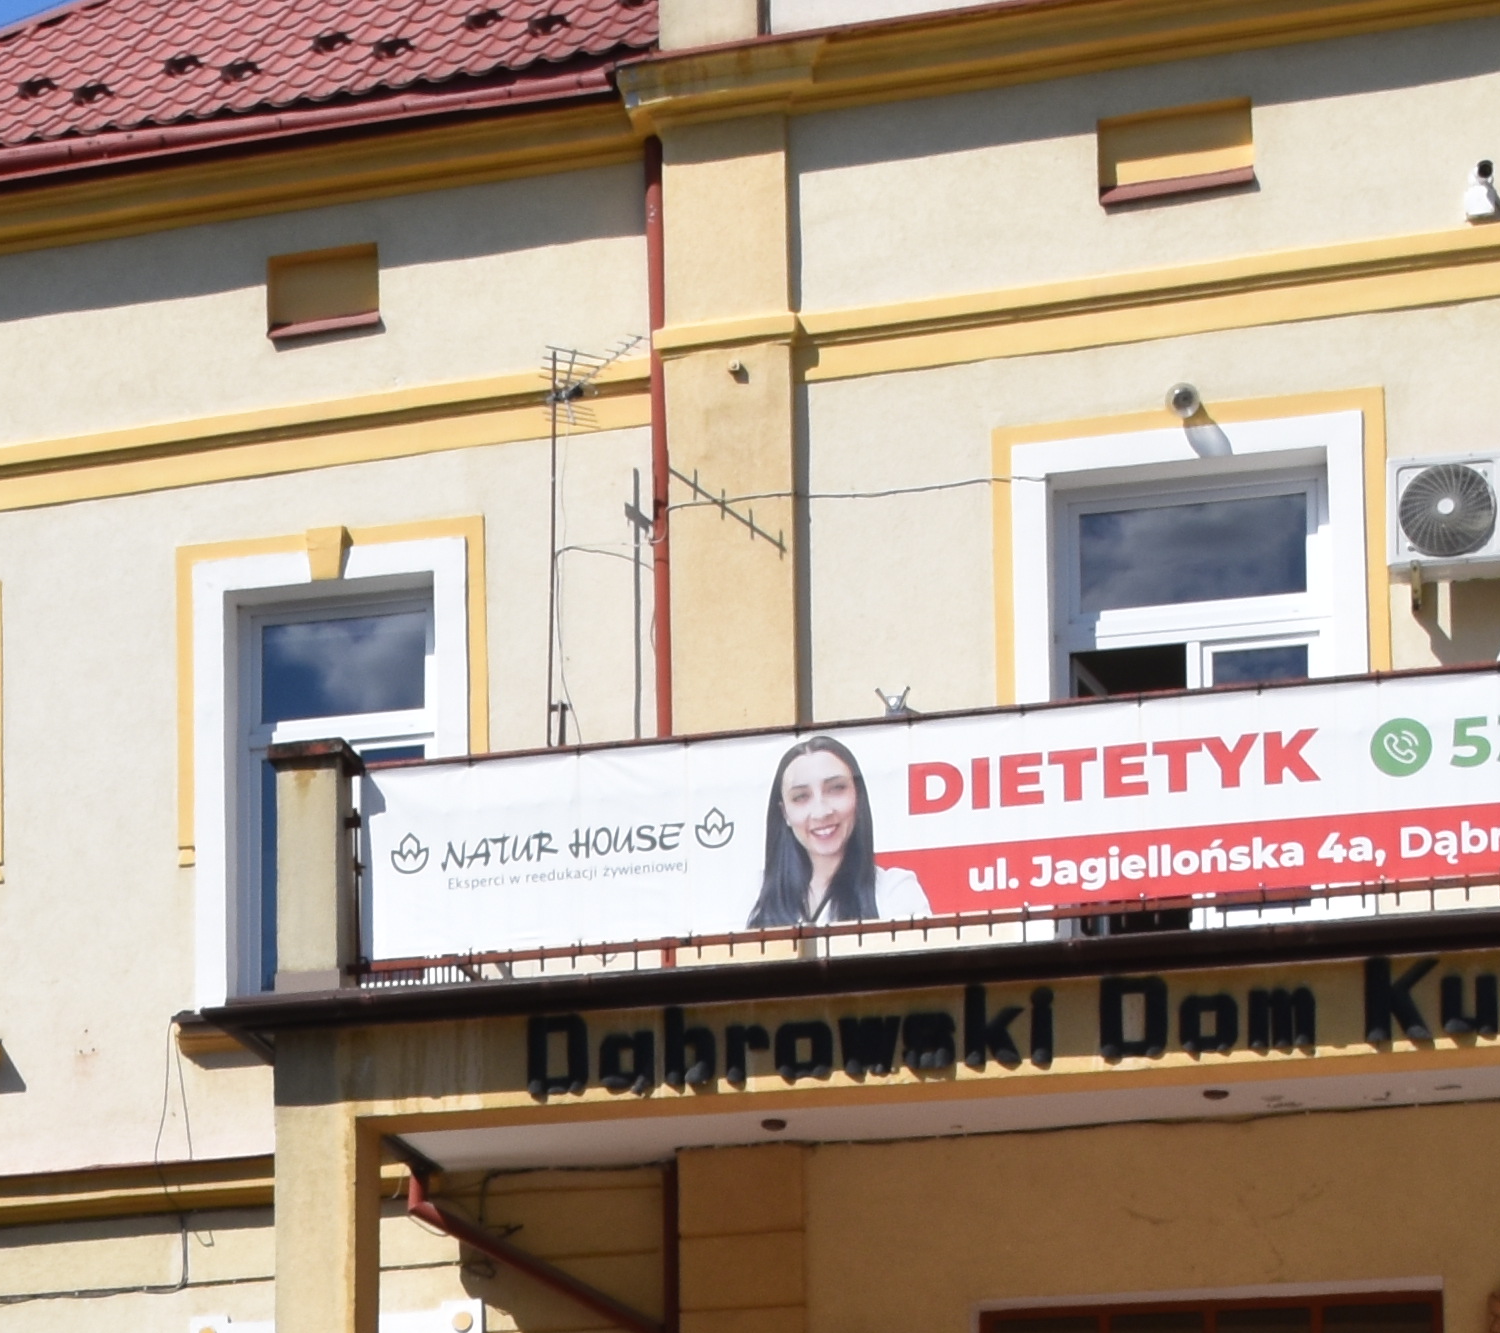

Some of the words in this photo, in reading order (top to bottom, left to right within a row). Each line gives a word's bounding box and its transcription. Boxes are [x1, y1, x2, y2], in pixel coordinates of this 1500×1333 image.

[908, 728, 1321, 816] DIETETYK
[441, 831, 559, 872] NATUR
[568, 822, 685, 859] HOUSE
[448, 876, 505, 890] Eksperci
[509, 876, 521, 885] w
[525, 867, 600, 884] reedukacji
[603, 859, 689, 879] żywieniowej
[968, 857, 1020, 892] ul.
[1031, 836, 1305, 891] Jagiellońska
[1317, 832, 1387, 868] 4a,
[1099, 974, 1316, 1062] Dom
